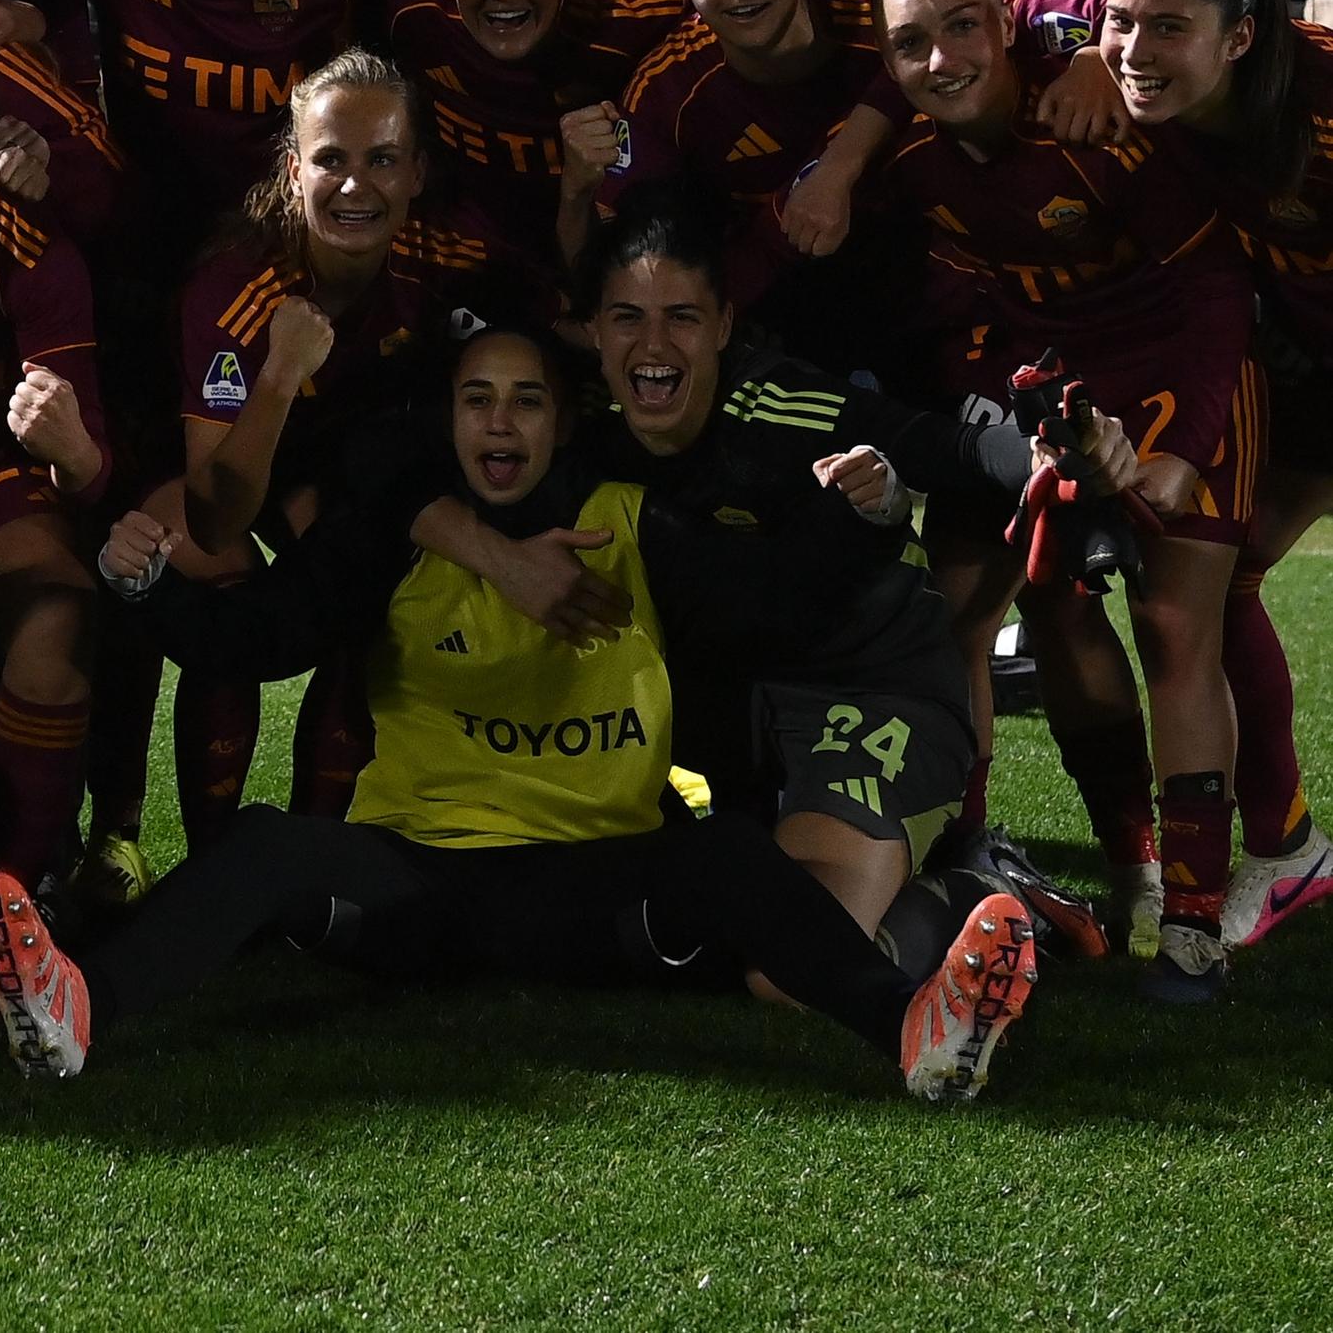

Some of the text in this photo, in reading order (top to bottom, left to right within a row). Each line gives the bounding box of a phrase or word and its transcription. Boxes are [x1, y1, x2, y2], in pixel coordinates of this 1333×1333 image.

[496, 130, 563, 175] TI
[453, 707, 646, 757] TOYOTA
[811, 703, 912, 784] 24
